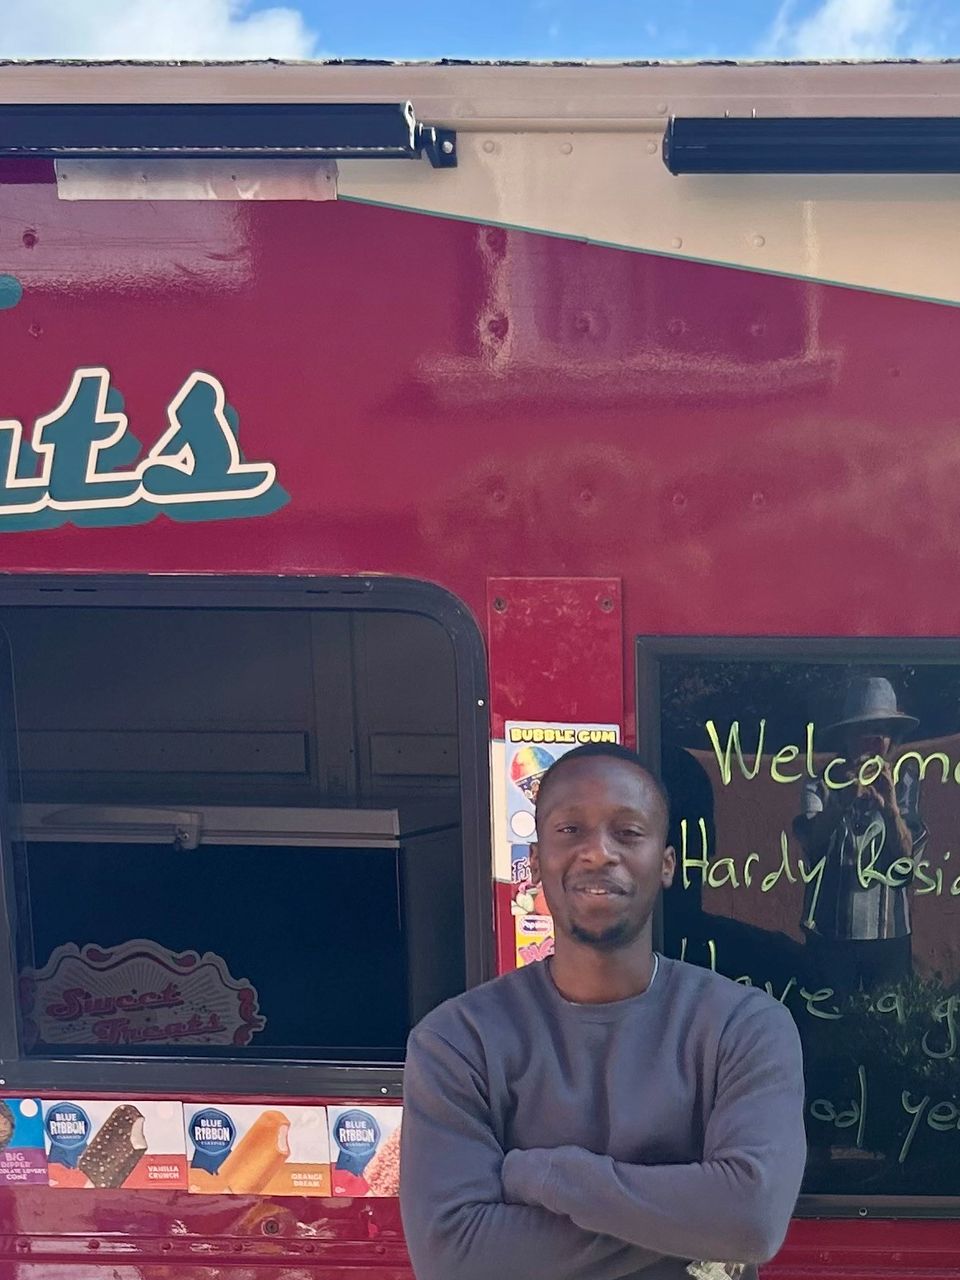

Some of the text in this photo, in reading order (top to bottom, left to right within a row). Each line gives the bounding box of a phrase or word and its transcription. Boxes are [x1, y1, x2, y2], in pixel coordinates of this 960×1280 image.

[509, 728, 617, 744] BUBBLE GUM
[680, 817, 827, 930] Hardy
[47, 982, 185, 1020] Sweet
[877, 992, 903, 1021] a
[92, 1012, 228, 1045] Treats
[55, 1113, 77, 1122] BLUE
[200, 1119, 223, 1127] BLUE
[345, 1121, 367, 1129] BLUE
[50, 1121, 86, 1136] RIBBON
[194, 1127, 230, 1141] RIBBON
[339, 1128, 375, 1143] RIBBON
[5, 1152, 25, 1161] BIG
[147, 1165, 179, 1173] VANILLA
